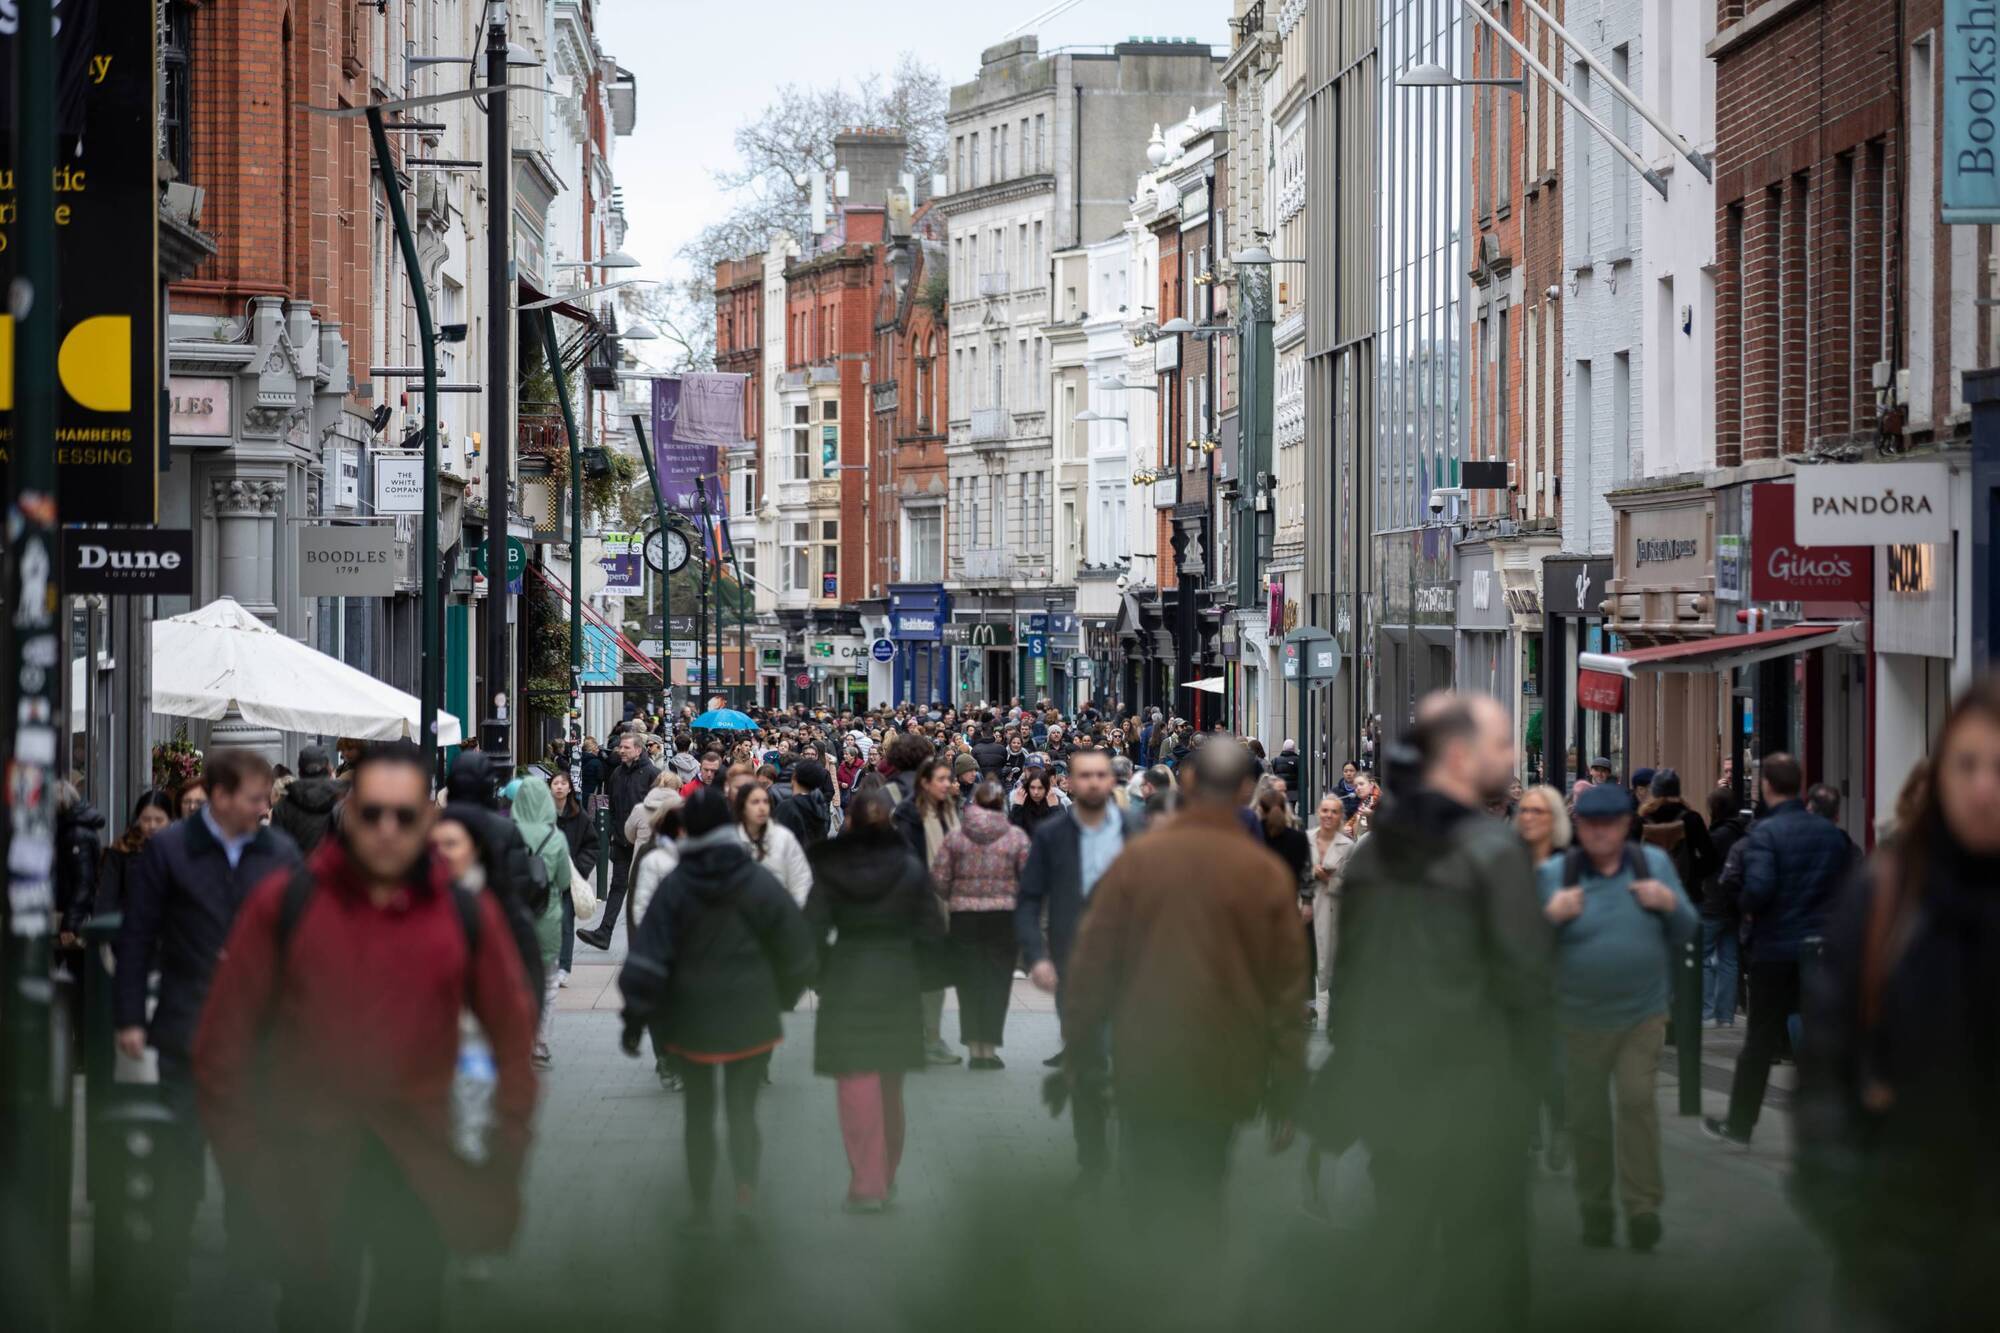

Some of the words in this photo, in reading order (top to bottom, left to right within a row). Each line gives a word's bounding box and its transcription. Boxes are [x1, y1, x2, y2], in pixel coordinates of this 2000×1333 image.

[1955, 0, 1997, 177] Booksh
[170, 396, 214, 415] LES
[54, 428, 132, 442] HAMBERS
[78, 545, 181, 569] Dune
[307, 551, 387, 563] BOODLES
[1768, 547, 1853, 580] Gino's
[1790, 577, 1842, 586] GELATO
[1033, 639, 1042, 654] S
